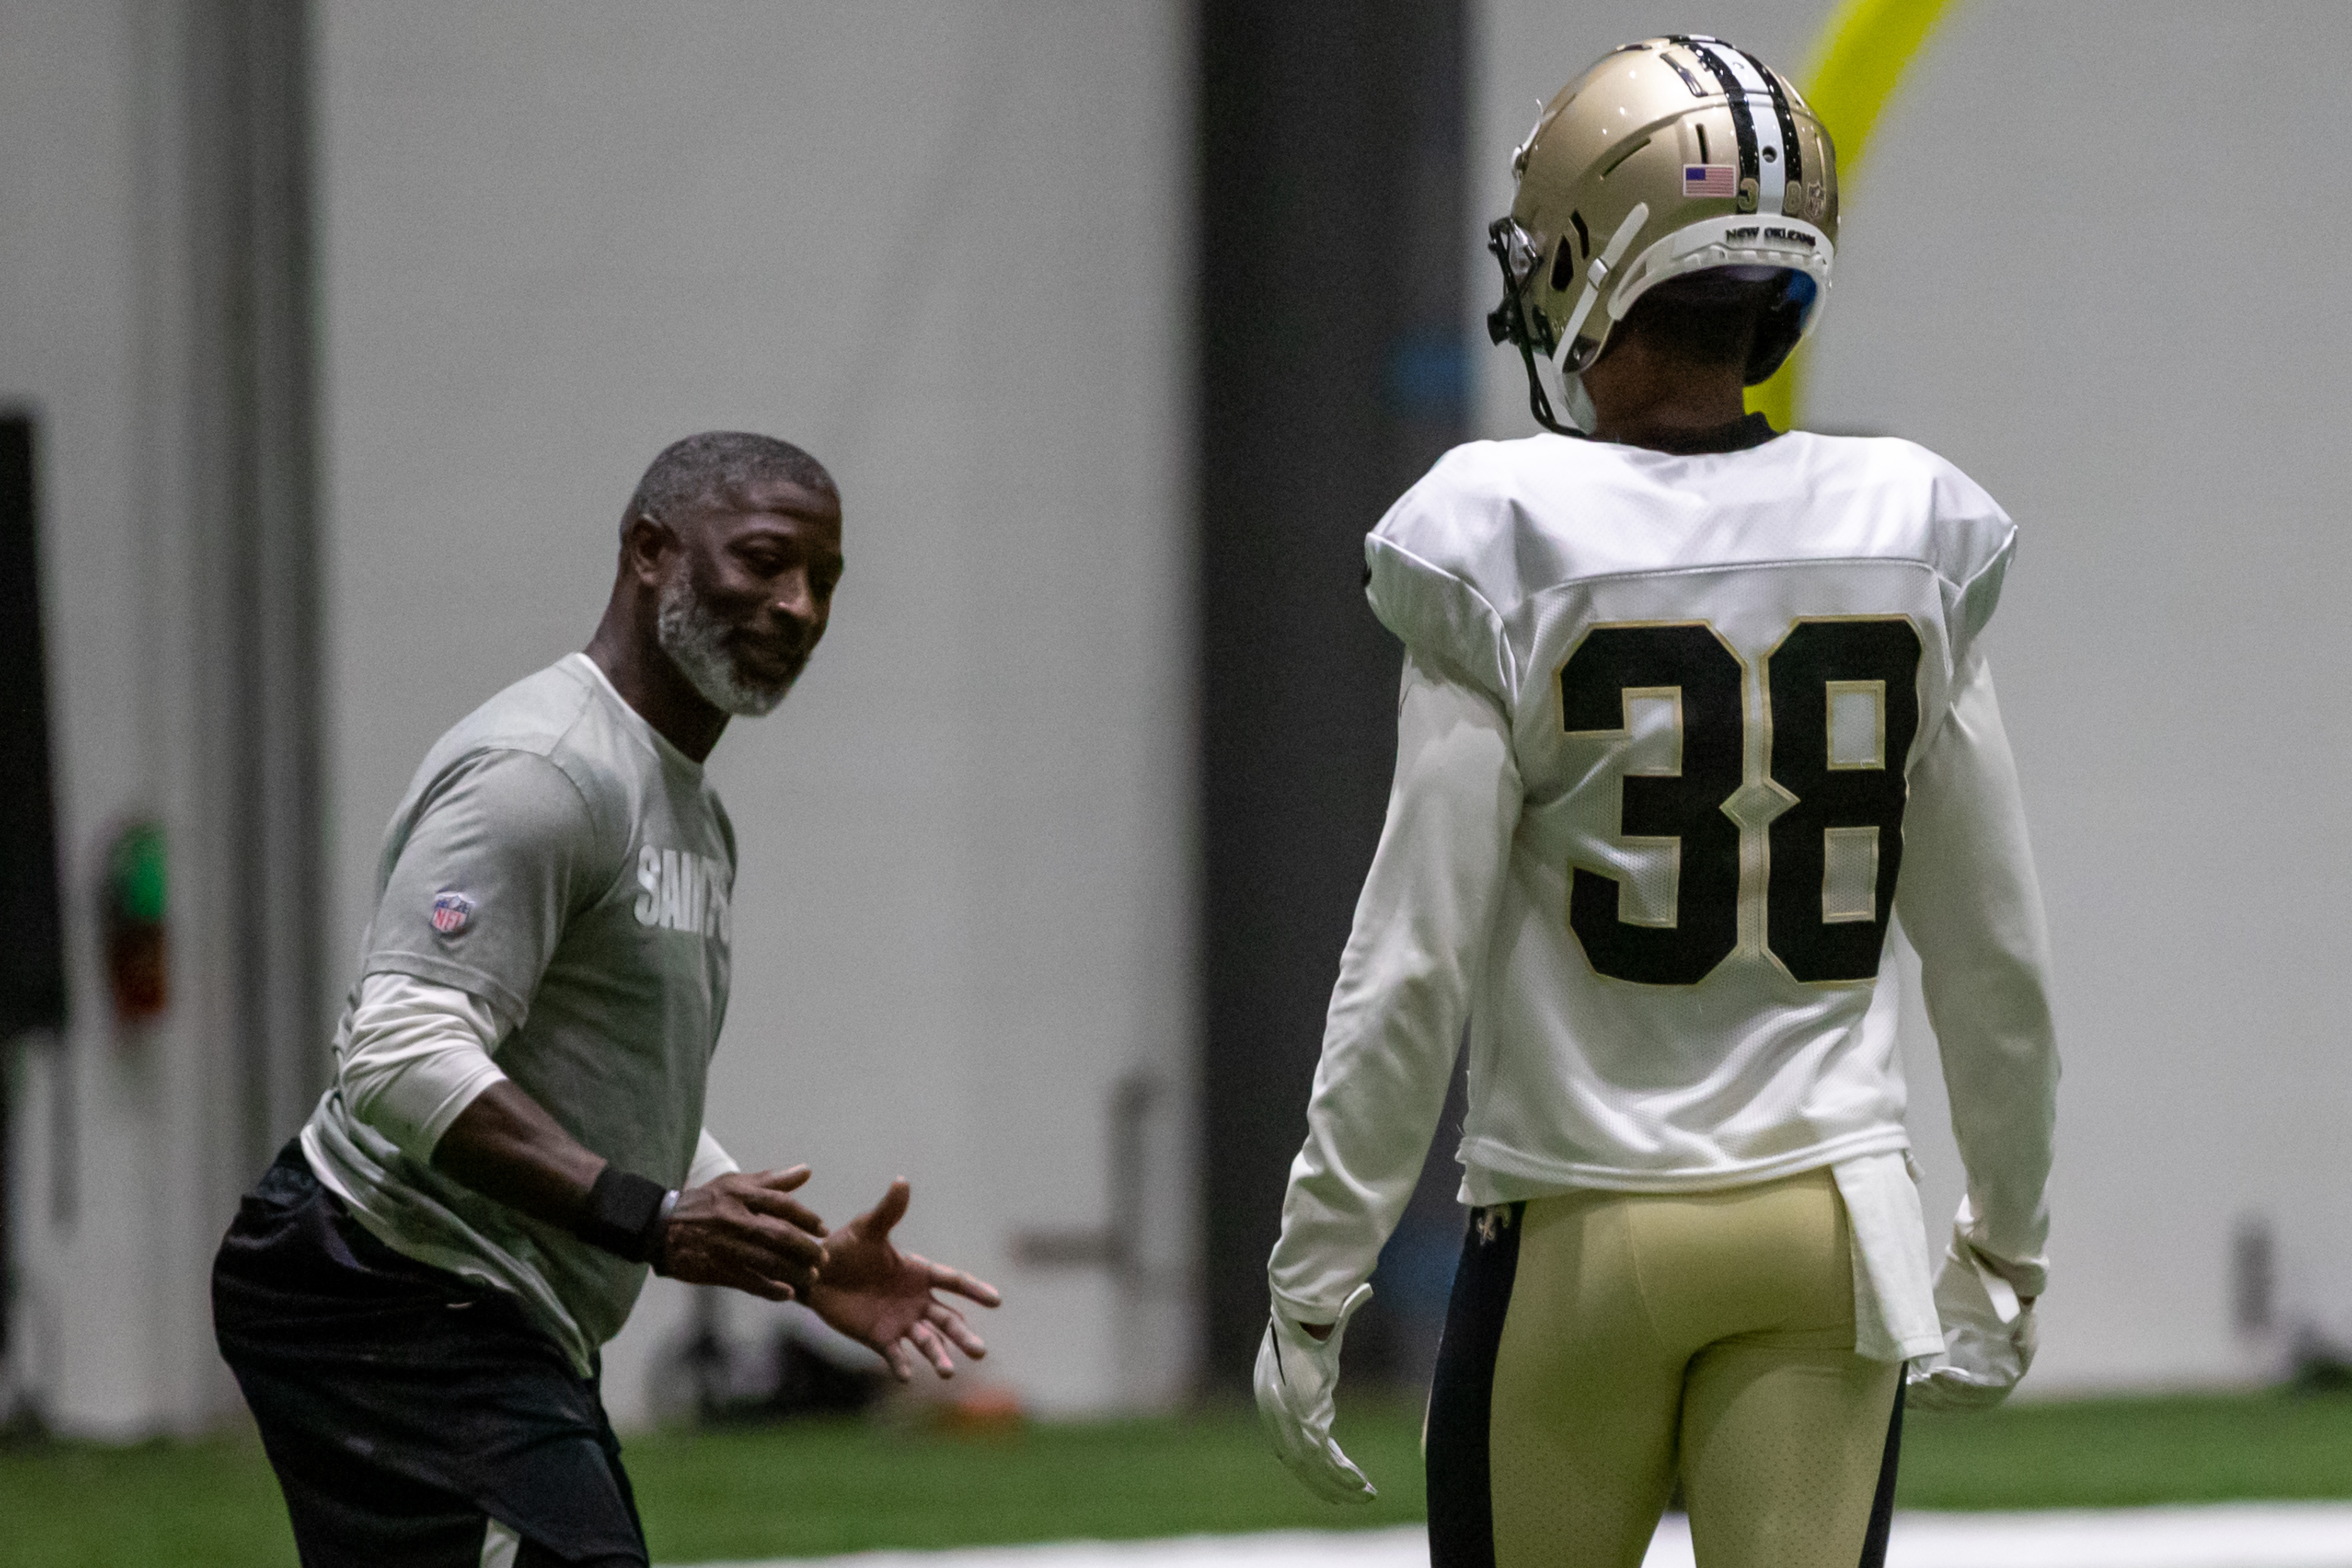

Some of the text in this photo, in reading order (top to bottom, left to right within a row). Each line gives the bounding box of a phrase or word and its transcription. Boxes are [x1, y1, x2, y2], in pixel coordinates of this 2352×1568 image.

[1739, 178, 1801, 213] 3 8
[1725, 226, 1816, 247] NEW ORLEANS
[1552, 613, 1923, 985] 38
